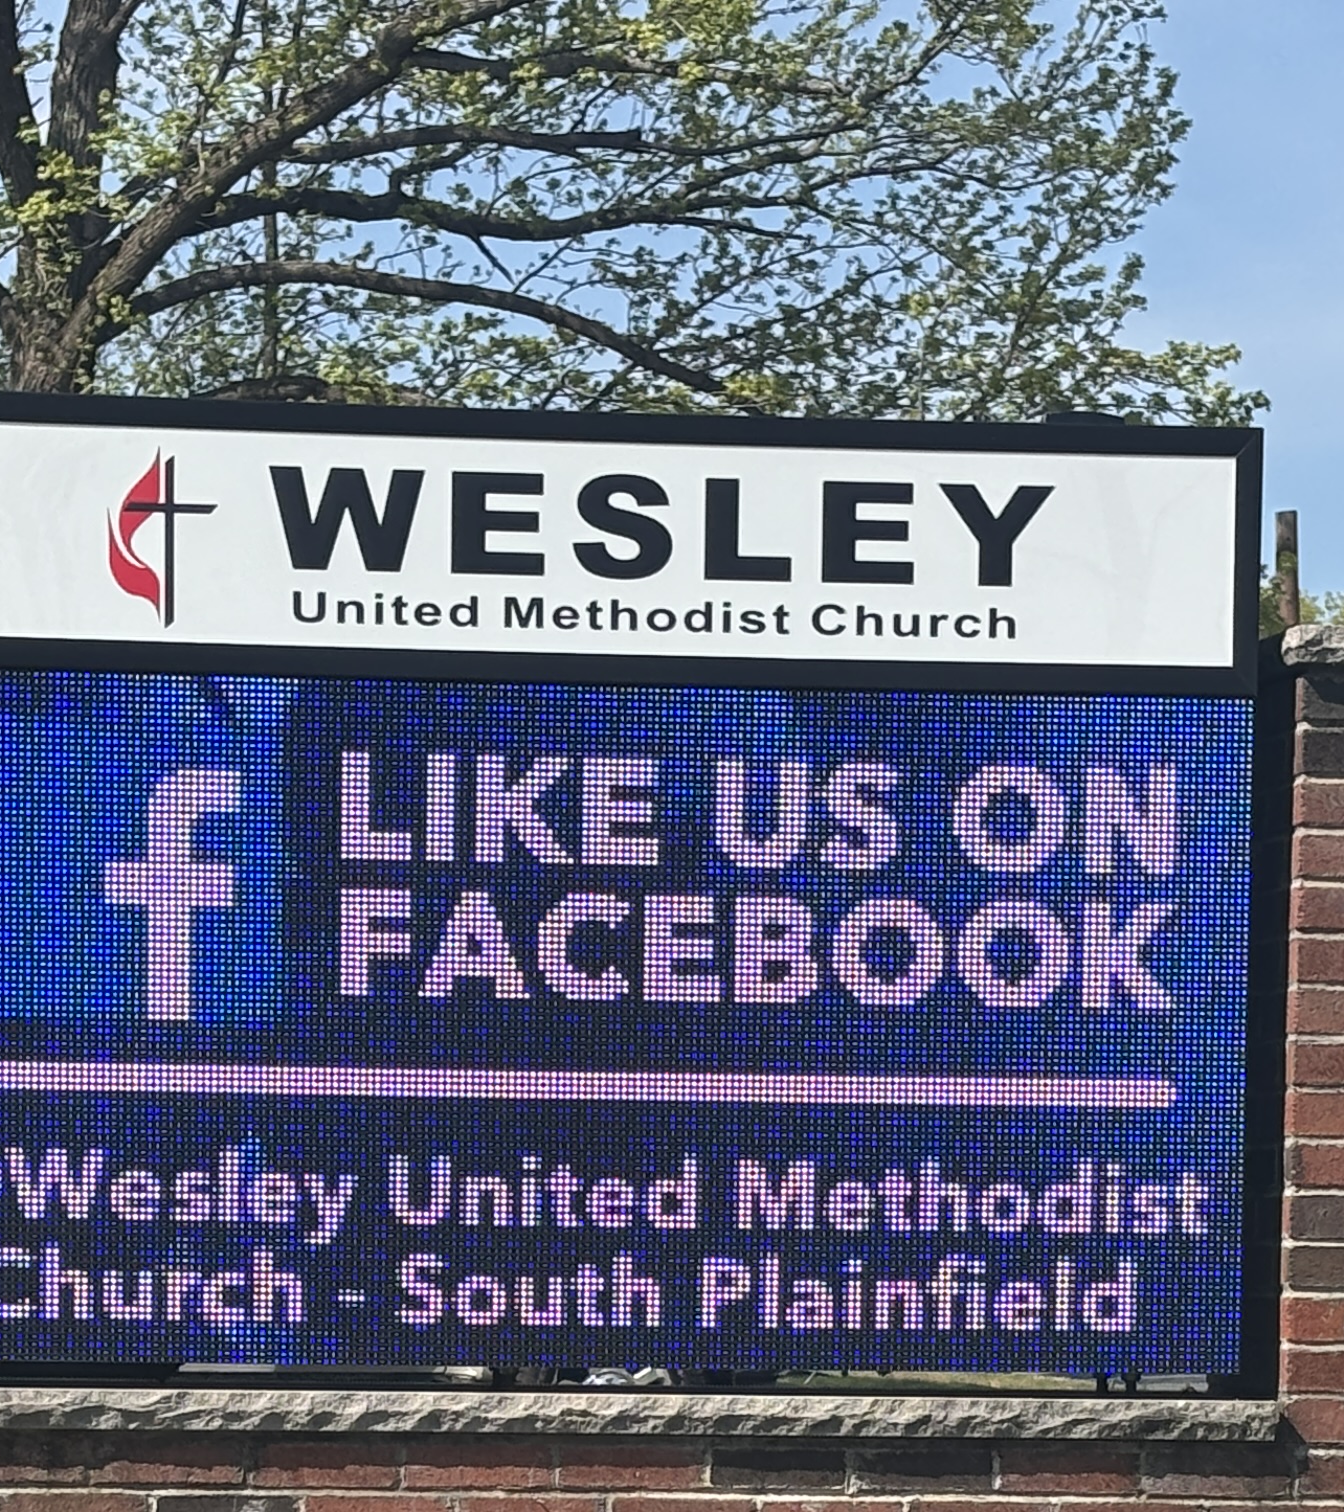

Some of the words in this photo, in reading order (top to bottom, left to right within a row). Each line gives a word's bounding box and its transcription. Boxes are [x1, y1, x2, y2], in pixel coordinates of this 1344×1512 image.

[269, 466, 1055, 587] WESLEY
[292, 590, 479, 628] United
[503, 596, 791, 635] Methodist
[811, 603, 1017, 639] Church
[340, 751, 658, 867] LIKE
[714, 757, 899, 870] US
[953, 763, 1177, 874] ON
[104, 768, 241, 1020] f
[340, 888, 1177, 1009] FACEBOOK
[388, 1153, 697, 1229] United
[737, 1157, 1209, 1235] Methodist
[398, 1251, 660, 1327] South
[701, 1252, 1138, 1333] Plainfield
